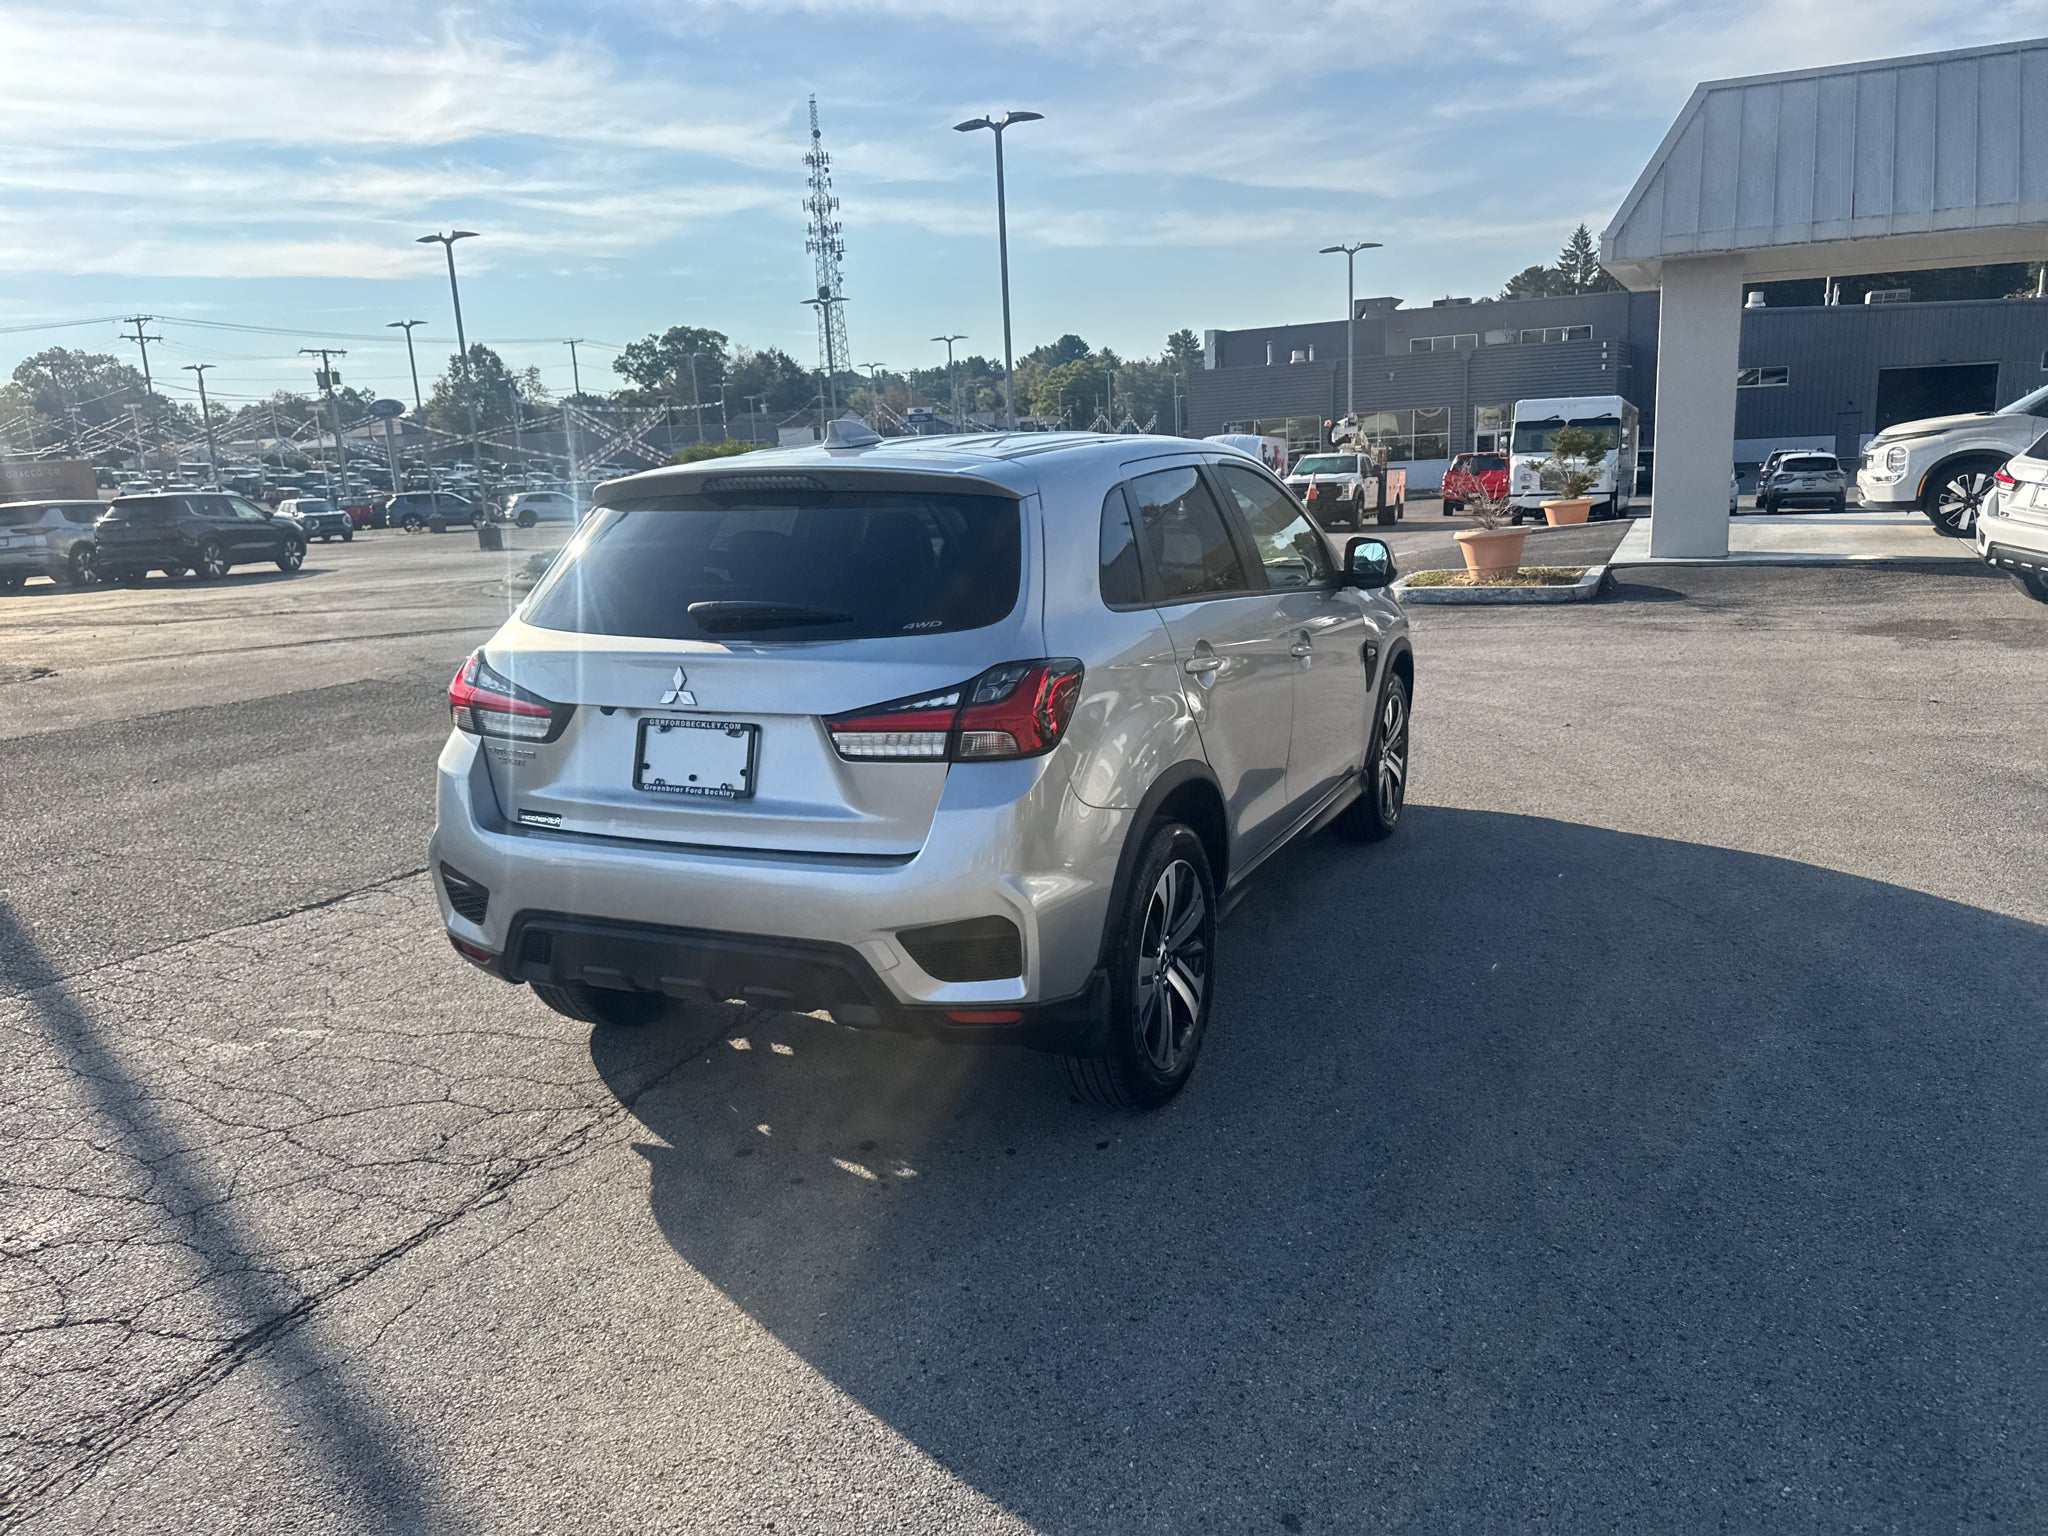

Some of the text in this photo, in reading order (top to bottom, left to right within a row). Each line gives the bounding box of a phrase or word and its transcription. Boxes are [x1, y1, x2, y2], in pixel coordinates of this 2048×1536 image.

[649, 718, 741, 730] GBRFORDBECKLEY.COM
[643, 783, 736, 799] Greenbrier Ford Beckley
